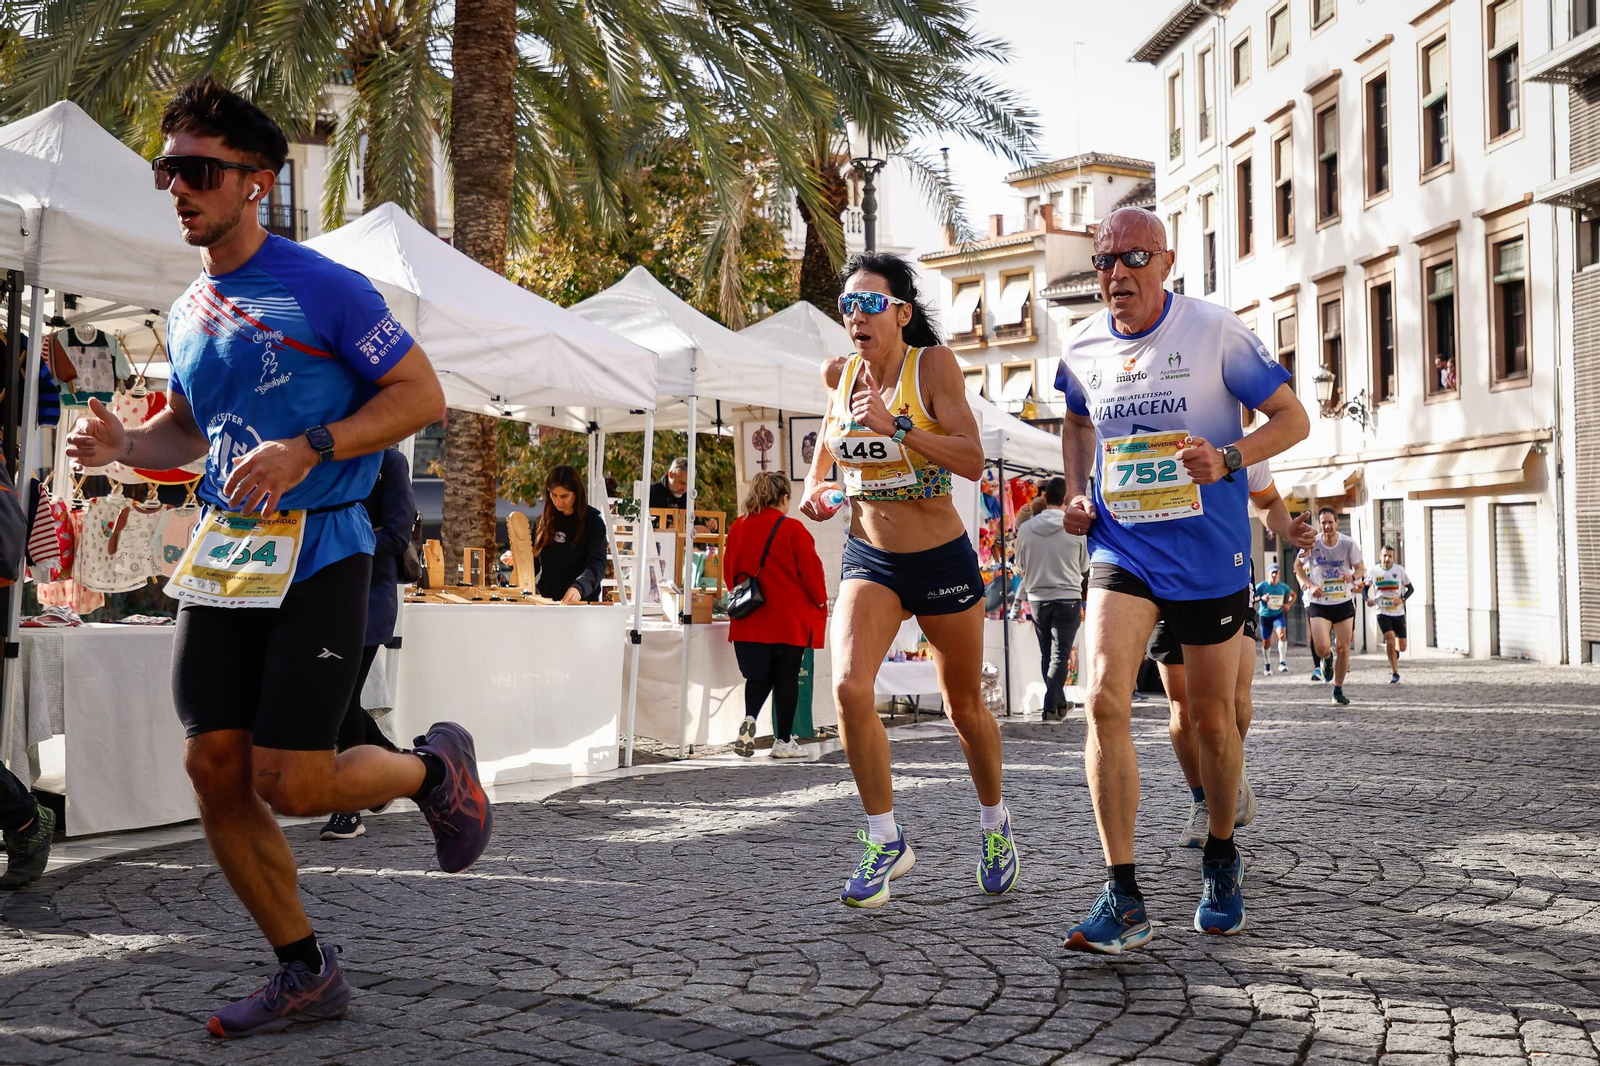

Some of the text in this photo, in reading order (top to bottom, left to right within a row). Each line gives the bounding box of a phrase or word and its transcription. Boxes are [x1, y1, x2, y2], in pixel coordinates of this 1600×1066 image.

[1116, 371, 1148, 383] mayfo
[1100, 396, 1115, 404] CLUB
[1129, 391, 1173, 400] ATLETISMO
[1092, 397, 1188, 421] MARACENA
[840, 442, 888, 459] 148
[1117, 460, 1178, 486] 752
[1324, 585, 1344, 593] 1241
